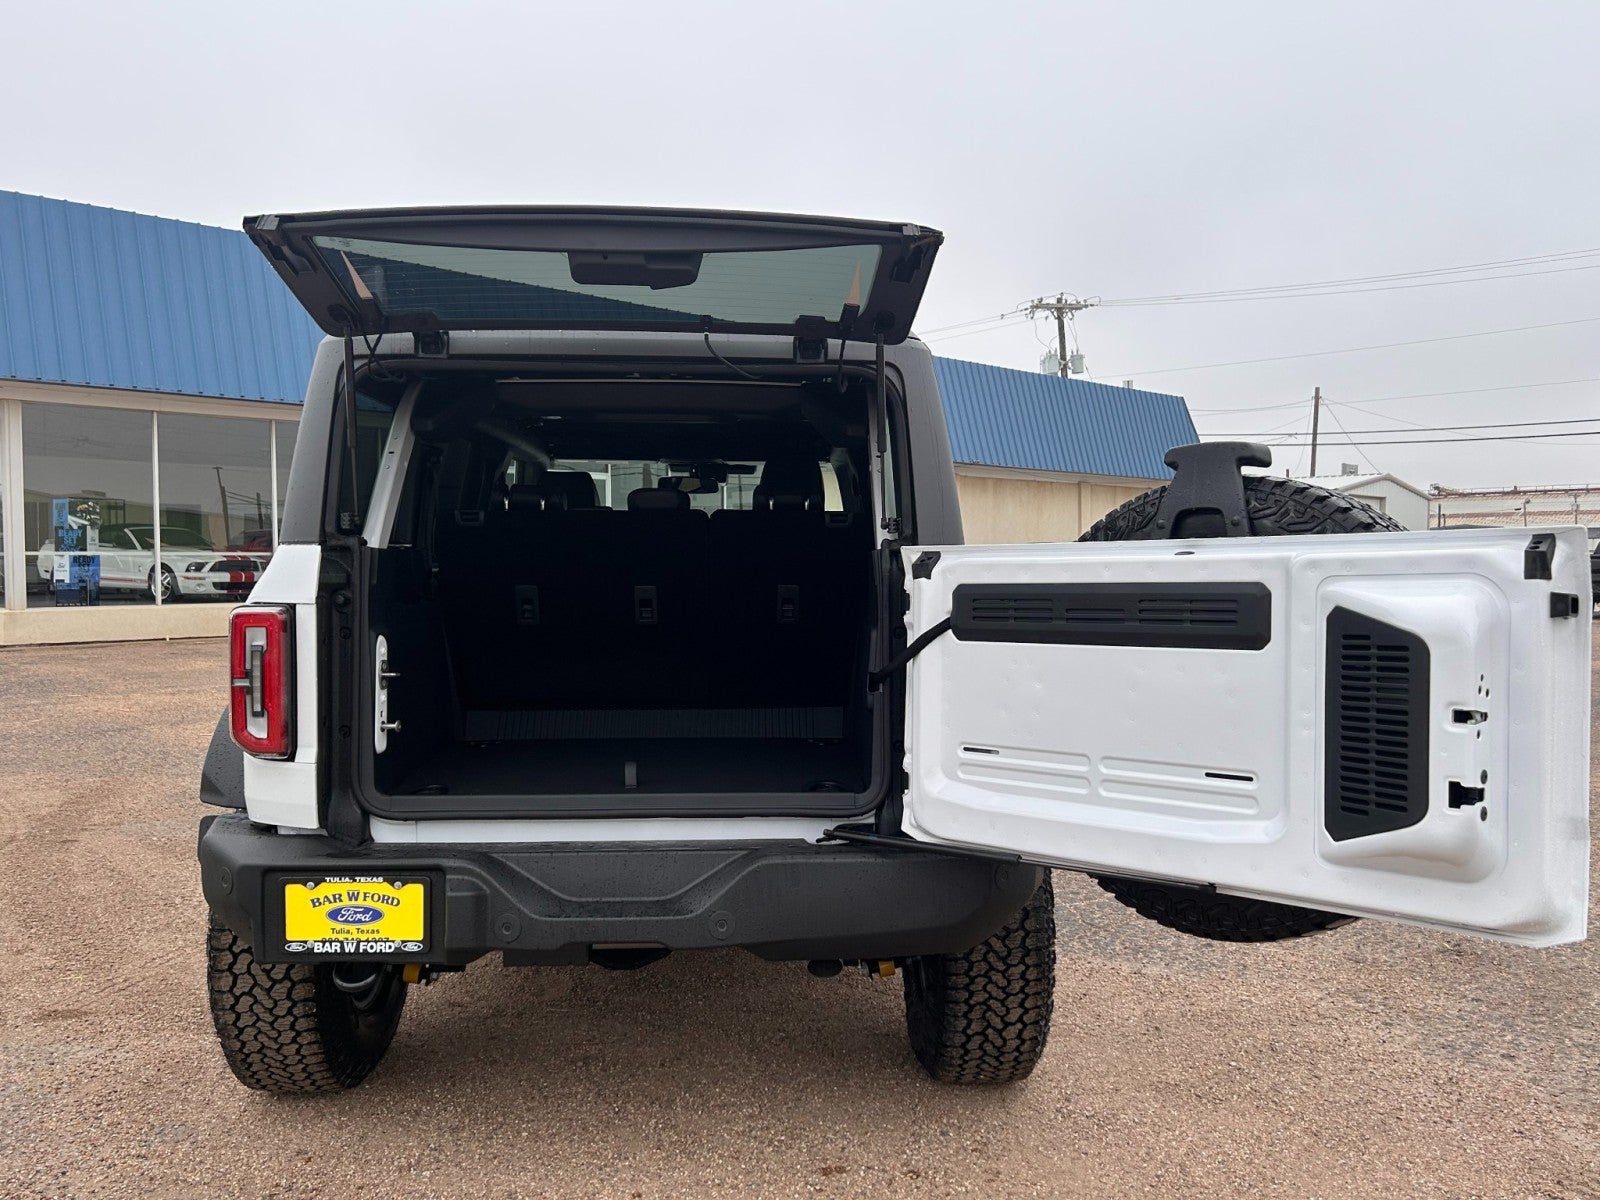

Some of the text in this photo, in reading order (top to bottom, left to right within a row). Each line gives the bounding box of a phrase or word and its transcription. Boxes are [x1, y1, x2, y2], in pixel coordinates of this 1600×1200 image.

[310, 891, 401, 908] BAR W FORD
[337, 907, 373, 922] Ford
[330, 927, 353, 935] Tulia,
[313, 941, 395, 953] BAR W FORD
